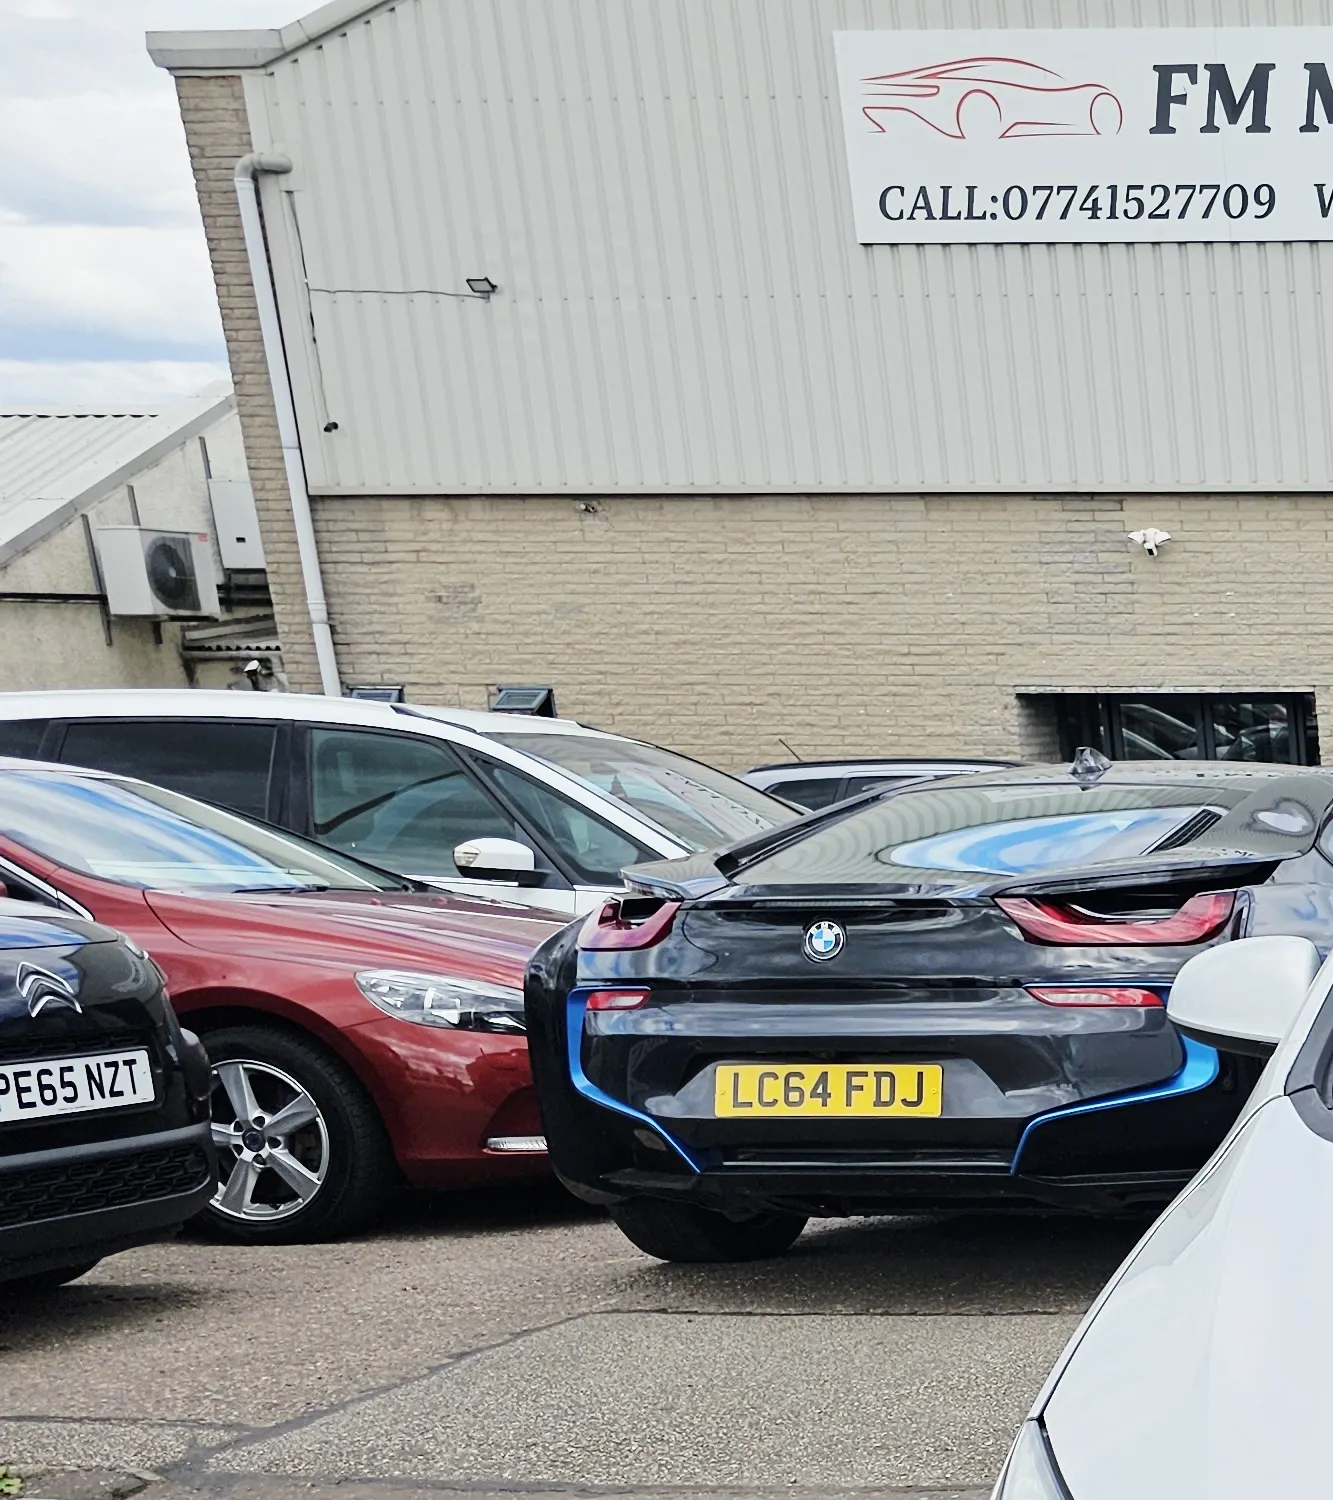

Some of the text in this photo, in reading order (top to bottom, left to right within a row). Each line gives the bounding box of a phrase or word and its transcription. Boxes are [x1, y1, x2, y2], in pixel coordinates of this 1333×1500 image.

[1149, 62, 1276, 134] FM
[879, 182, 1277, 222] CALL:07741527709
[85, 1058, 138, 1101] NZT
[732, 1071, 924, 1109] LC64 FDJ
